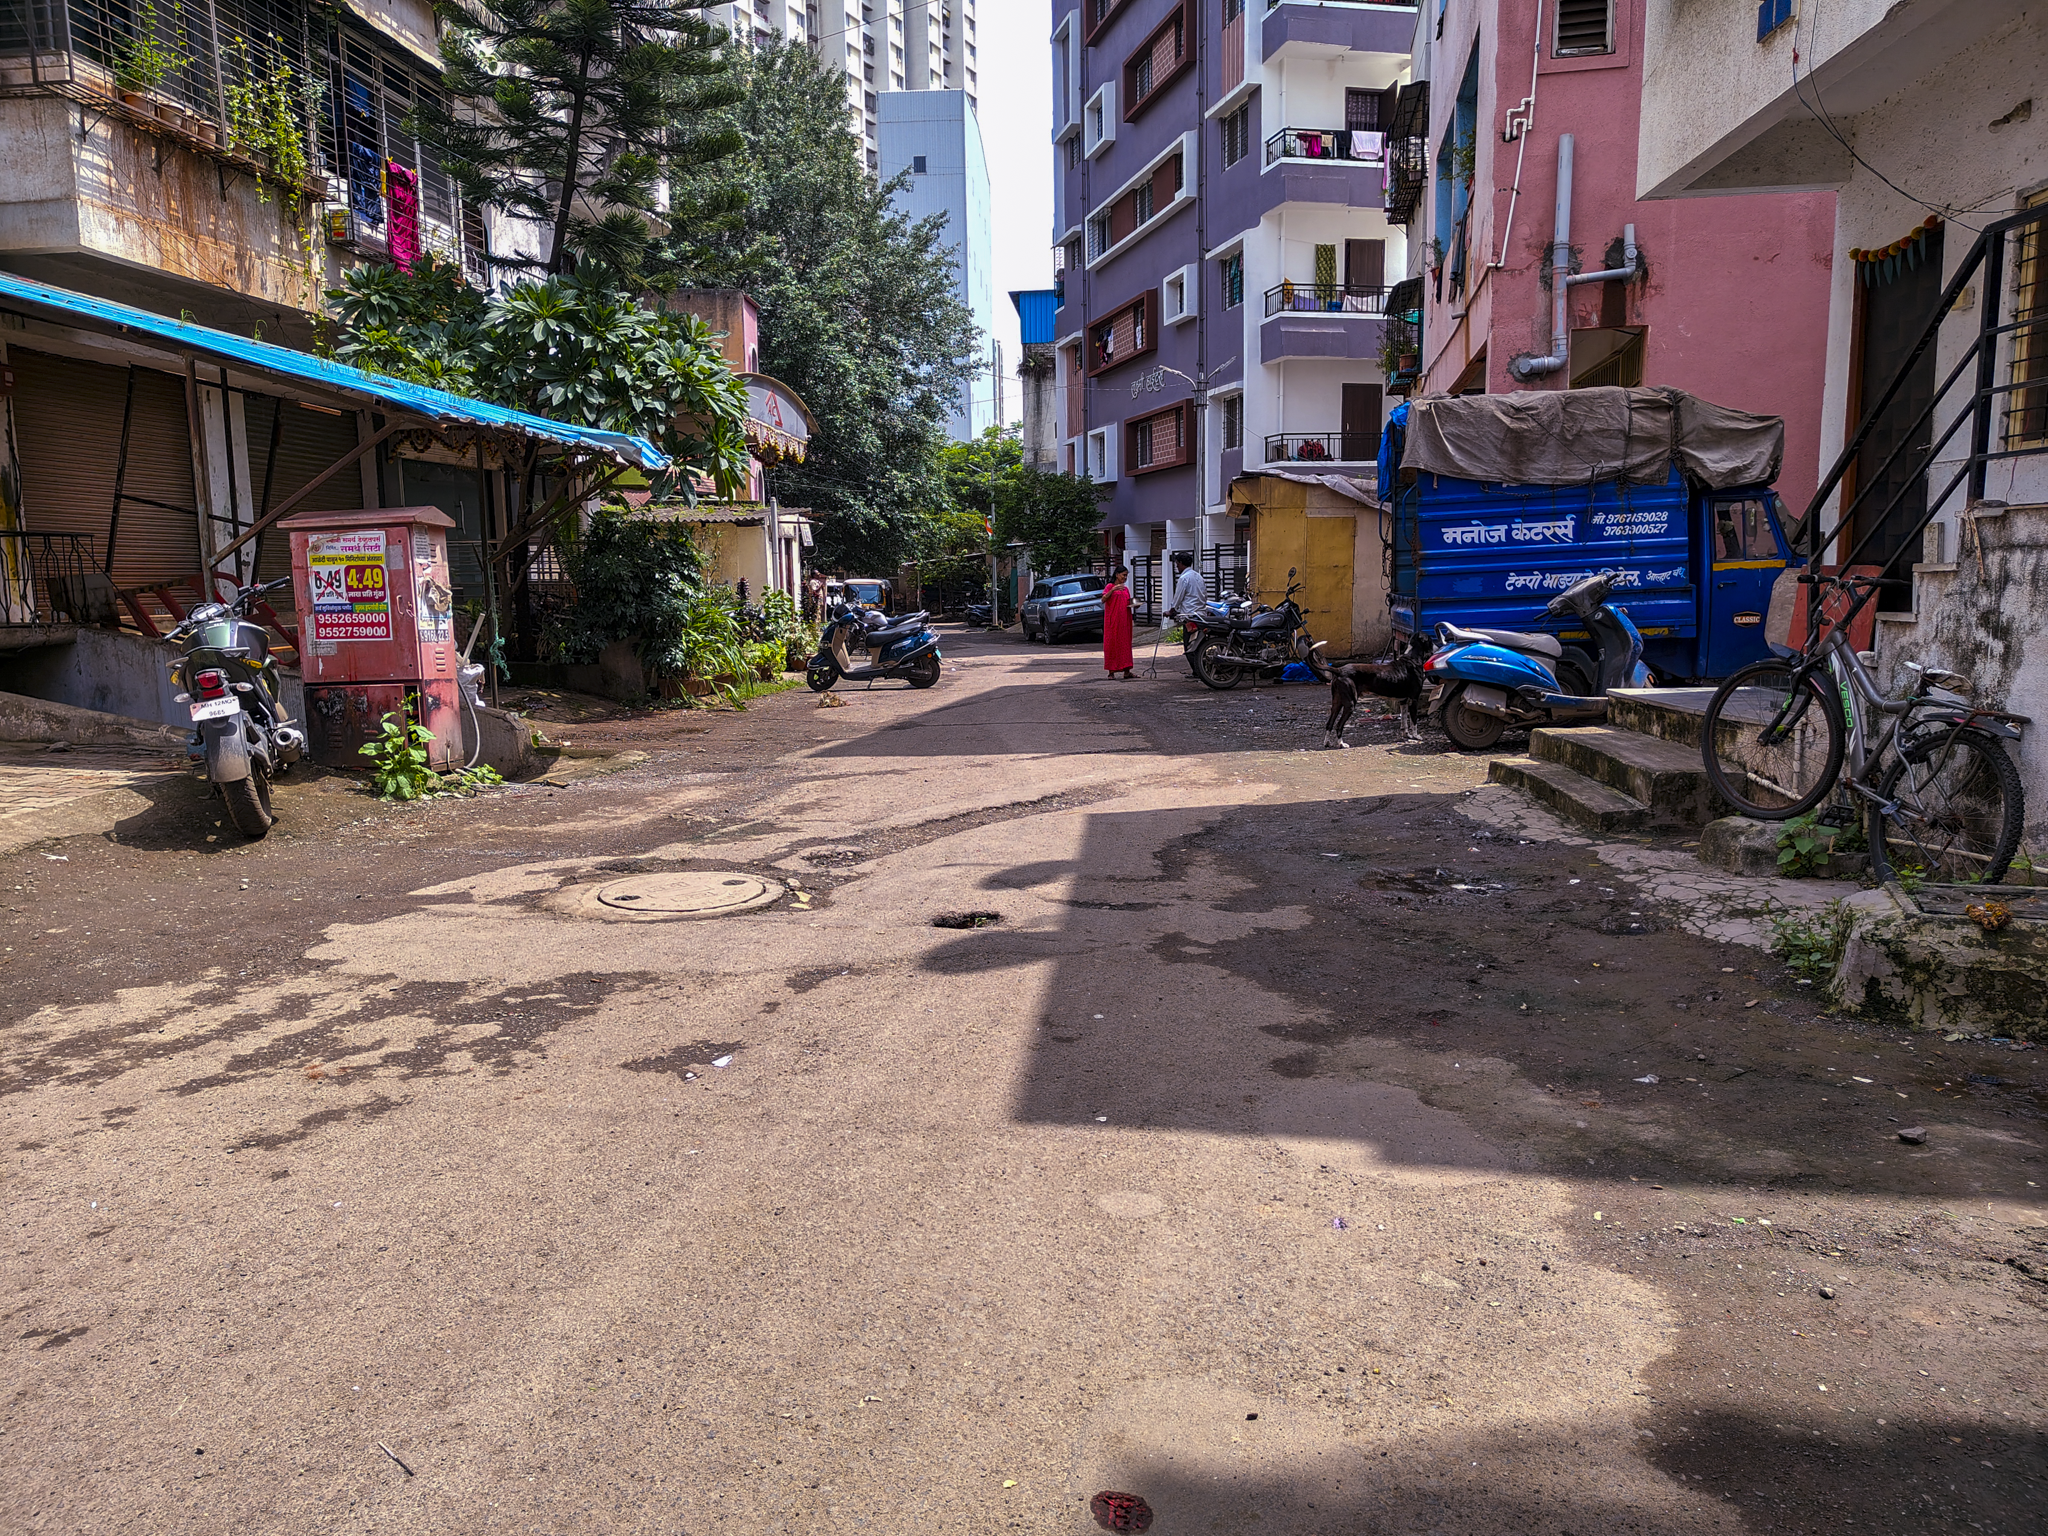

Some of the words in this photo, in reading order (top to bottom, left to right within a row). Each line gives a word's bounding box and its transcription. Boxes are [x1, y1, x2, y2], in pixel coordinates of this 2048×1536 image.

[1606, 512, 1668, 524] 9767159028
[1441, 520, 1508, 544] मनोज
[340, 543, 361, 552] समर्थ
[364, 543, 381, 552] सिटी
[347, 568, 383, 589] 4.49
[1505, 570, 1544, 590] टेम्पो
[318, 613, 386, 624] 9552659000
[319, 626, 387, 637] 9552759000
[1840, 681, 1853, 728] VESCO
